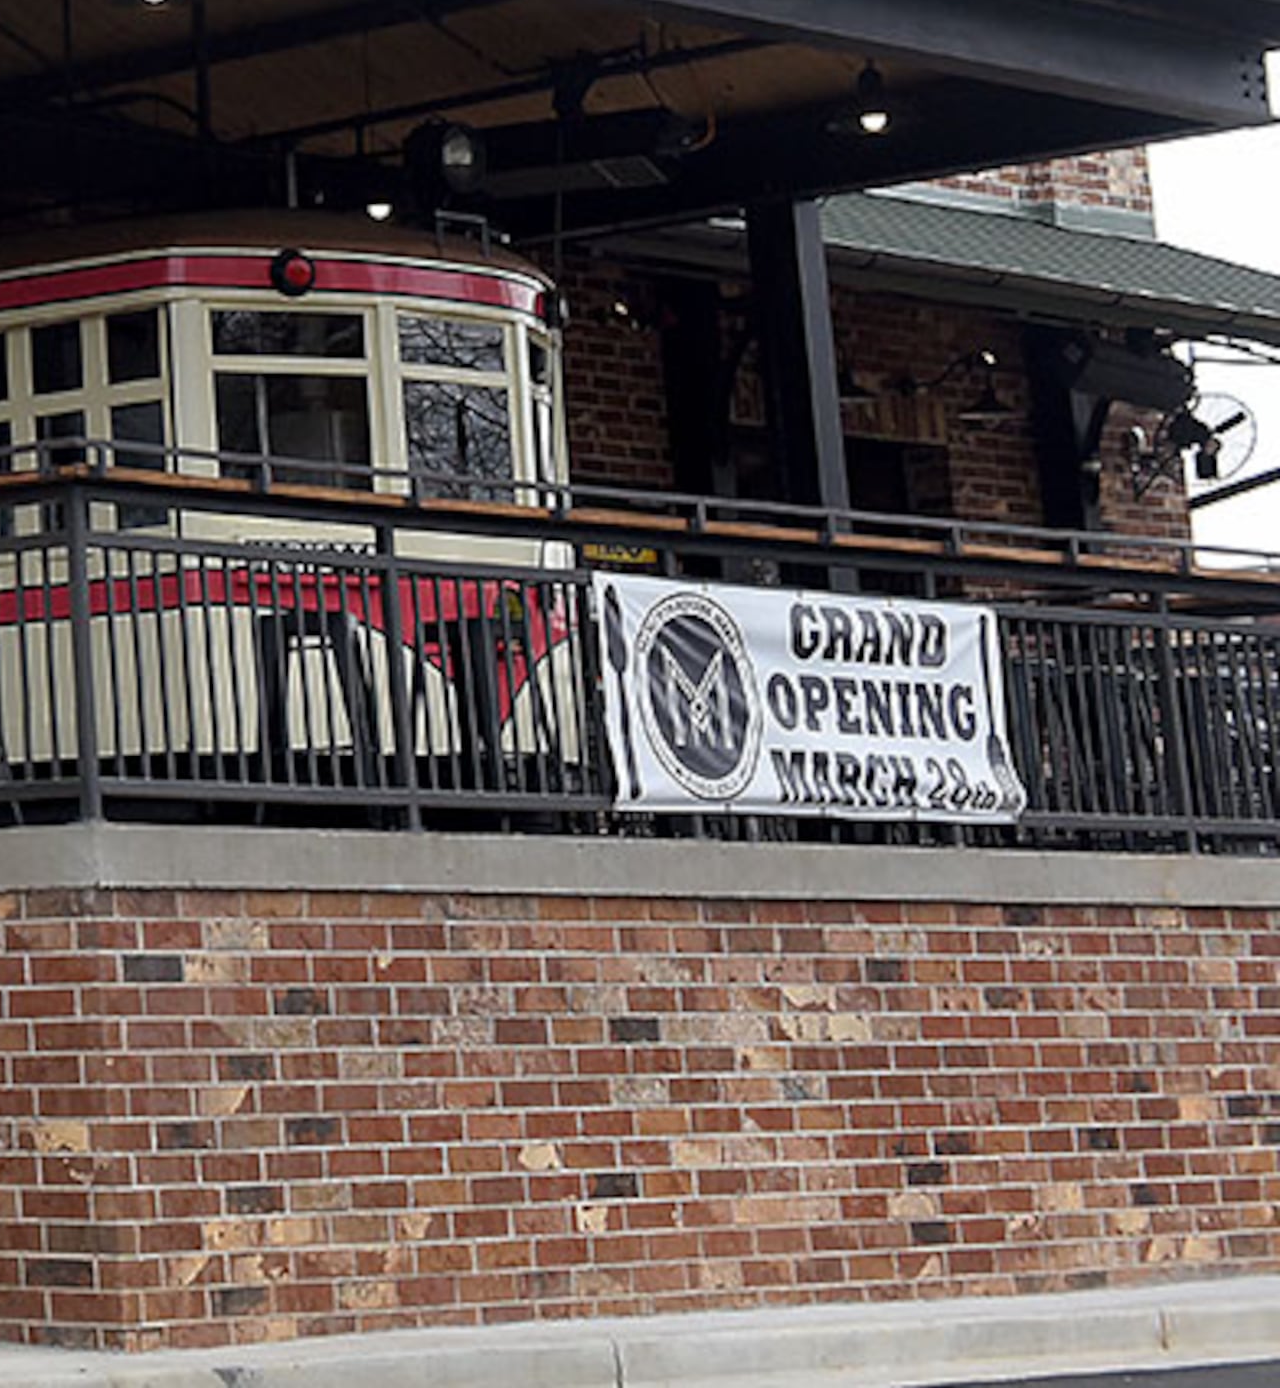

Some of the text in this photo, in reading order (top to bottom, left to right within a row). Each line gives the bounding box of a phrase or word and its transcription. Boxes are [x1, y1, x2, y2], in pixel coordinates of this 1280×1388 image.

[789, 603, 948, 667] GRAND
[766, 672, 977, 741] OPENING
[770, 749, 917, 807] MARCH
